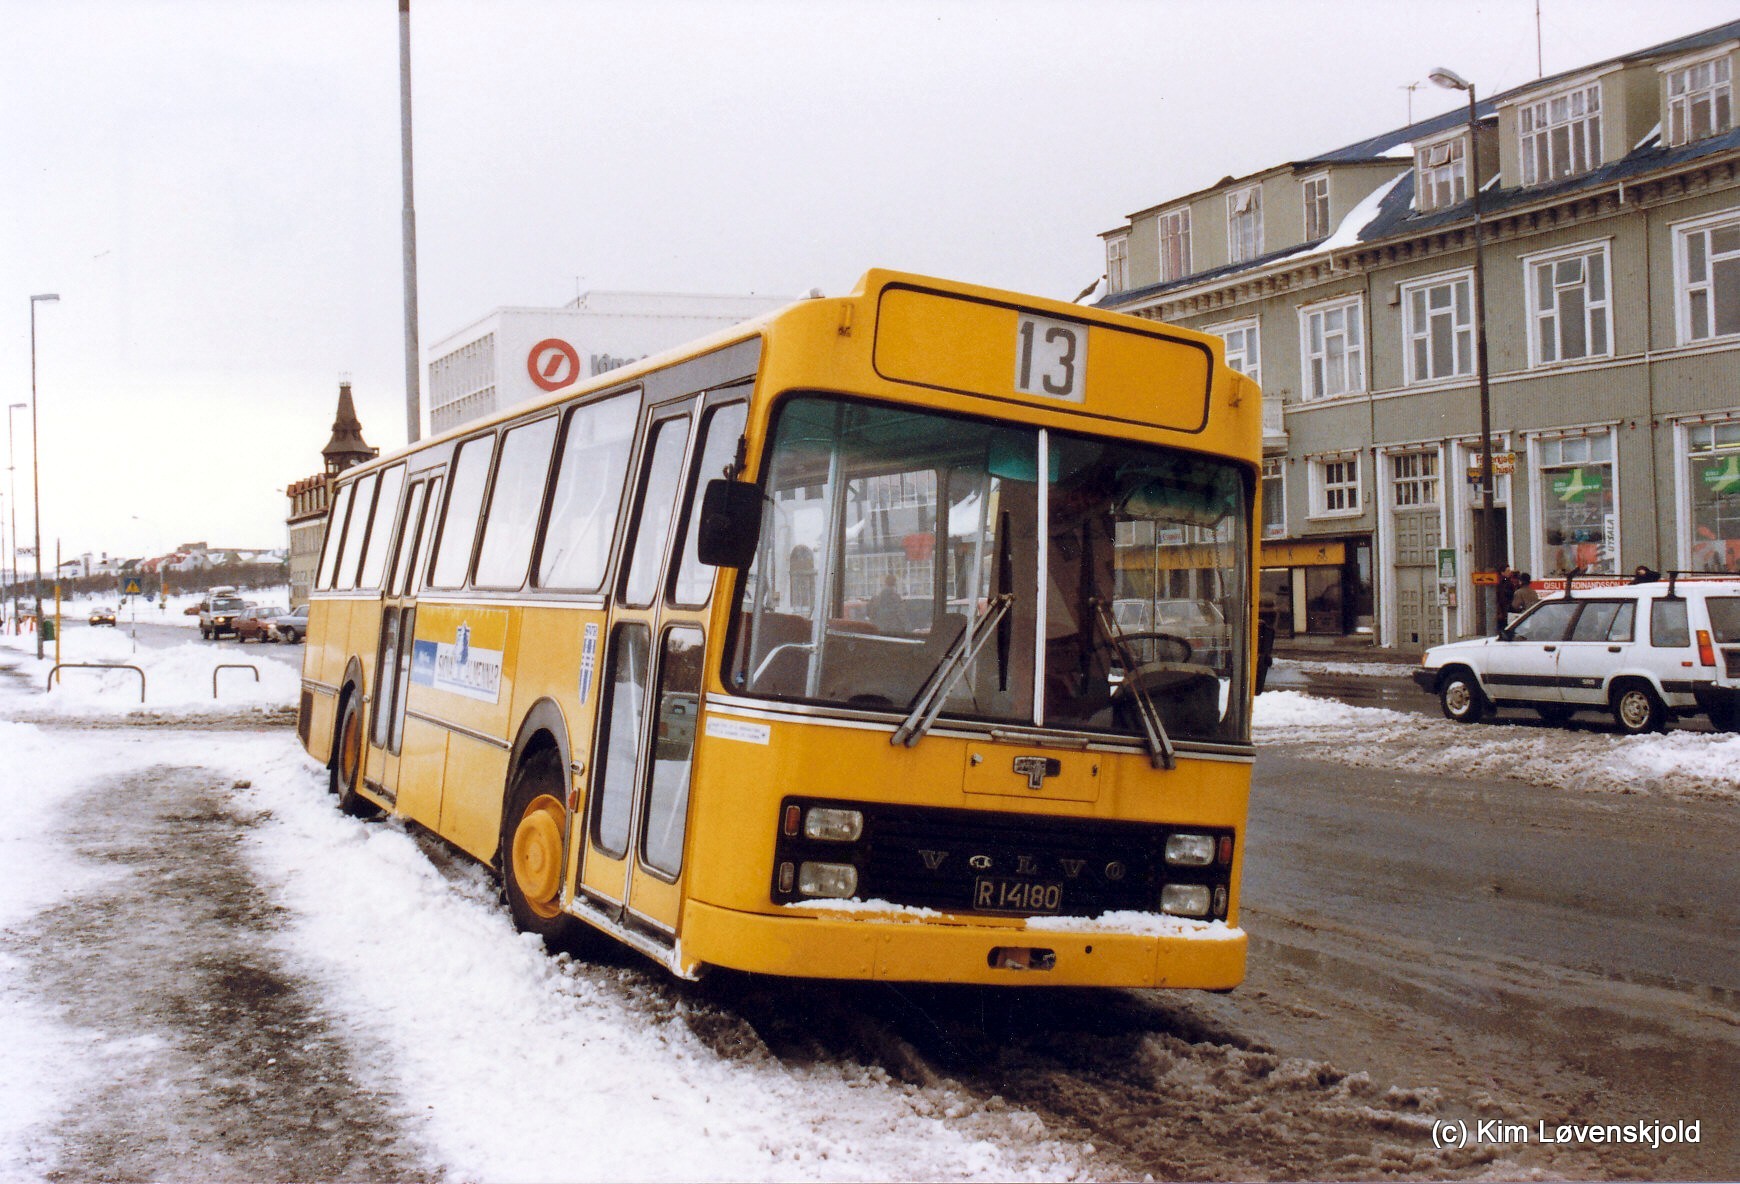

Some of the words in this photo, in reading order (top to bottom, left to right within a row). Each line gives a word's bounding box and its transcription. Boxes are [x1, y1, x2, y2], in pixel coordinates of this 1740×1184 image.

[1020, 321, 1077, 396] 13
[919, 850, 1126, 881] VOLVO
[979, 881, 994, 906] R
[1000, 882, 1059, 909] 14180
